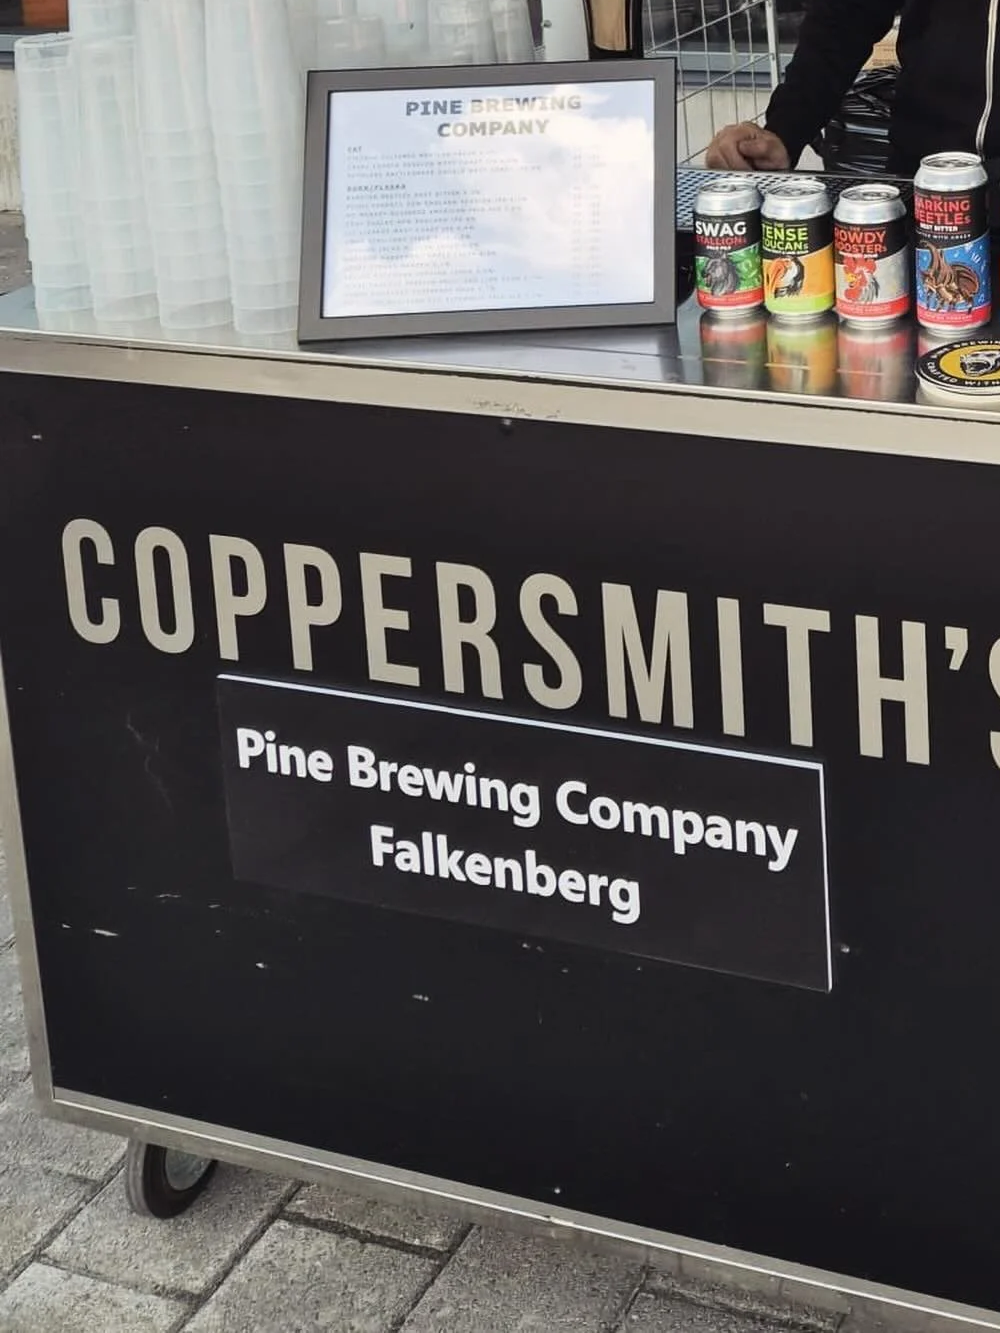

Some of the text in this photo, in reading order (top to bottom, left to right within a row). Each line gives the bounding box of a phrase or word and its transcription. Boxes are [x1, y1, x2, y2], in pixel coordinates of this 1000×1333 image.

[406, 95, 582, 116] PINE BREWING
[437, 119, 550, 137] COMPANY
[915, 195, 970, 212] ARKING
[695, 221, 747, 237] SWAG
[236, 727, 799, 872] Pine Brewing Company
[369, 824, 641, 925] Falkenberg
